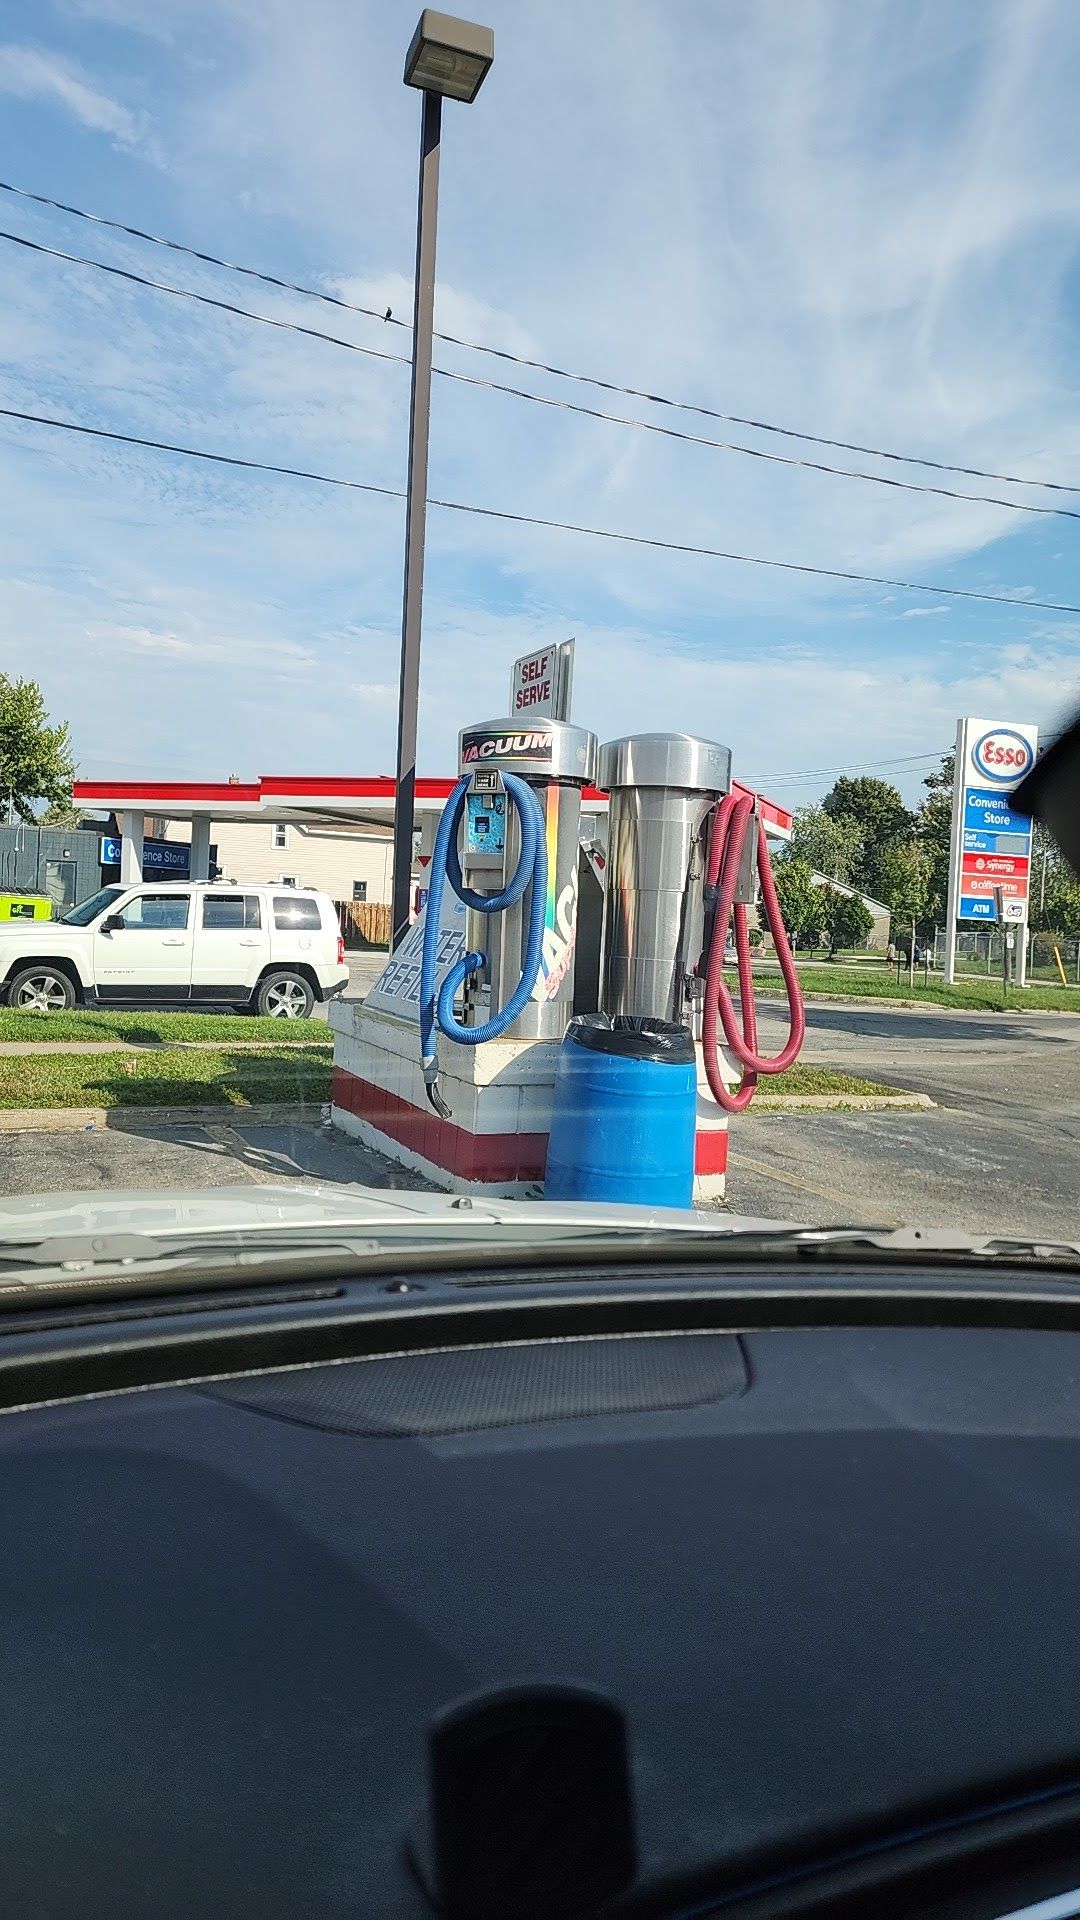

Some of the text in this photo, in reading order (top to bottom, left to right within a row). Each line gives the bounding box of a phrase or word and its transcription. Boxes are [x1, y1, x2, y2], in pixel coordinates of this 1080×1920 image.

[521, 656, 548, 684] SELF
[516, 680, 550, 709] SERVE
[462, 733, 553, 763] VACUUM
[968, 796, 1011, 810] Conveni
[984, 812, 1010, 825] Store
[964, 833, 977, 841] Self
[964, 842, 987, 850] service
[163, 850, 185, 864] Store
[986, 860, 1015, 873] Synergy
[972, 904, 990, 914] ATM
[401, 926, 465, 966] WTER
